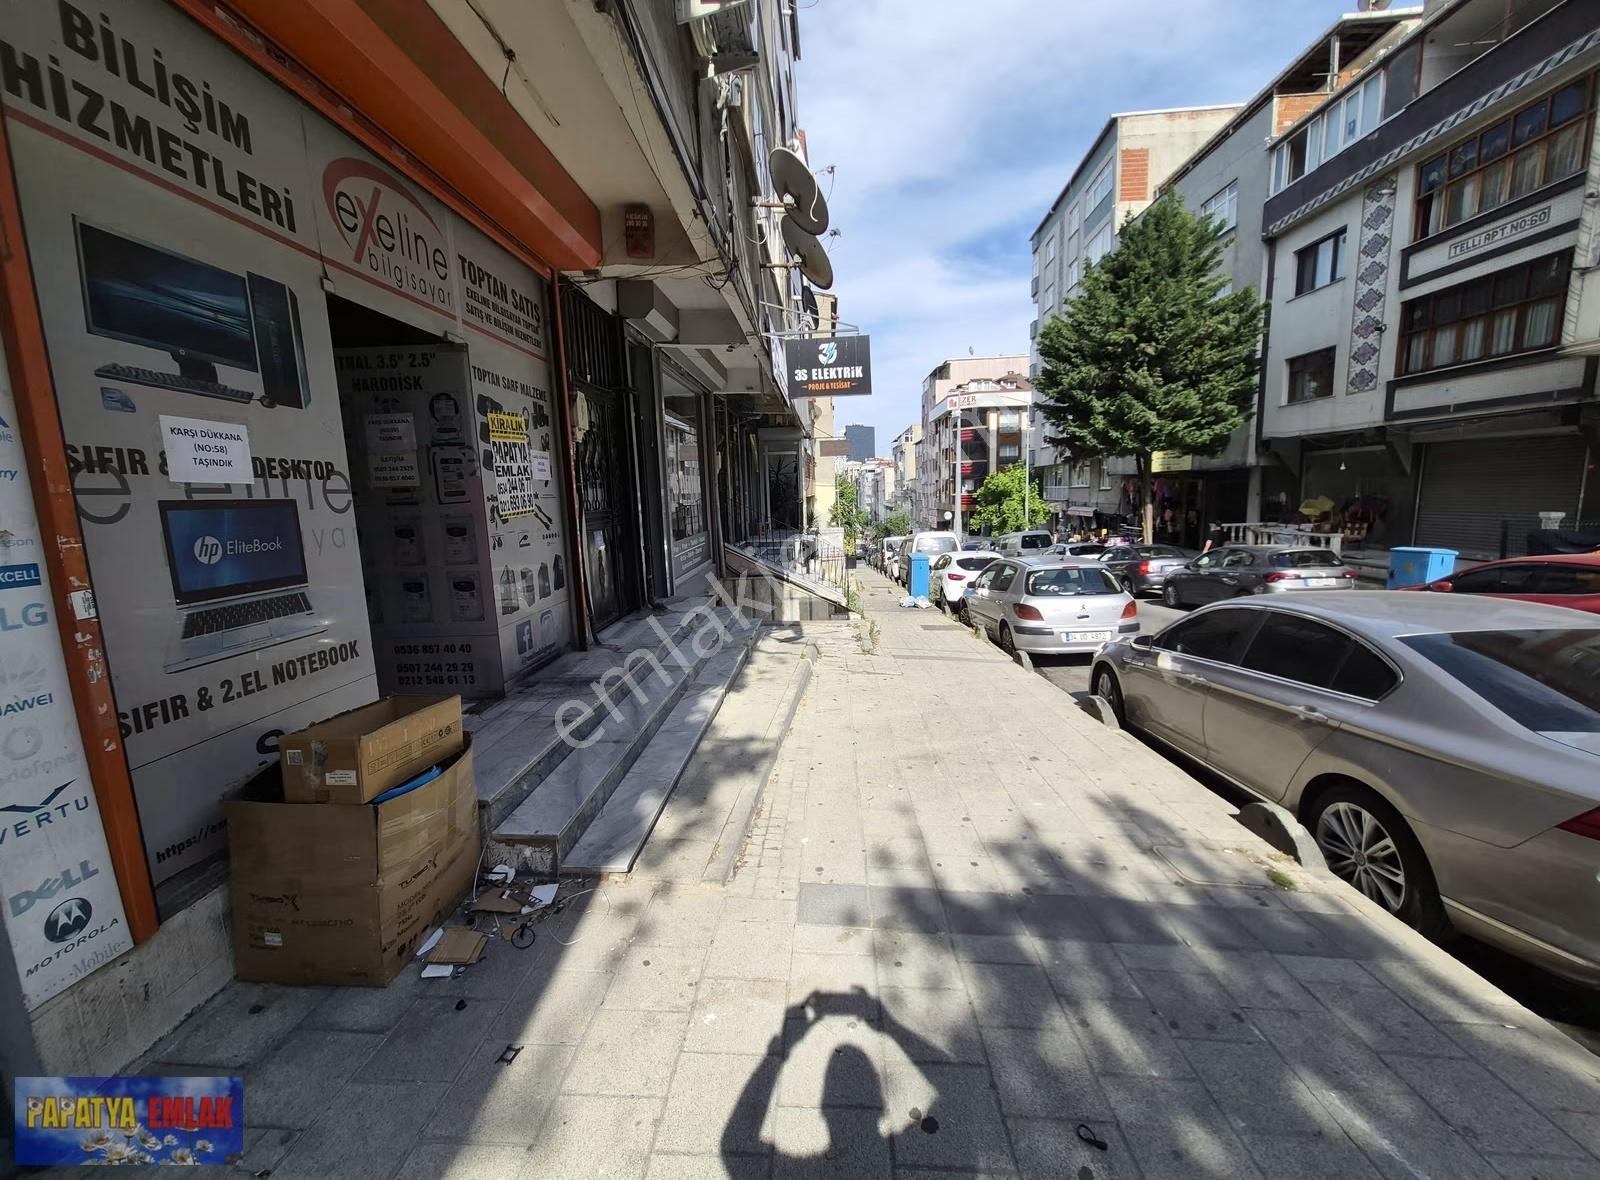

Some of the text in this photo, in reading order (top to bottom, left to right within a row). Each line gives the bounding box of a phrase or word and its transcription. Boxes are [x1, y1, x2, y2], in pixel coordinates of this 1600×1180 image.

[59, 0, 253, 155] BİLİŞİM
[0, 40, 297, 234] HİZMETLERİ
[458, 253, 508, 304] TOPTAN
[485, 313, 493, 324] VE
[408, 352, 436, 368] 2.5"
[794, 366, 863, 381] 3S ELEKTRİK
[472, 366, 547, 402] TOPTAN SARF MALZEME
[808, 383, 826, 391] PROJE
[490, 415, 525, 432] KİRALIK
[169, 427, 243, 442] KARŞI DÜKKANA
[194, 443, 228, 455] (NO:58)
[65, 444, 150, 476] SIFIR
[253, 456, 335, 481] DESKTOP
[192, 457, 233, 469] TAŞINDIK
[495, 466, 530, 478] EMLAK
[227, 537, 282, 555] EliteBook
[1, 603, 49, 632] LG
[119, 640, 360, 739] SIFIR & 2.EL NOTEBOOK
[0, 693, 53, 716] AWEI
[9, 860, 100, 917] DELL
[25, 918, 119, 977] MOTOROLA
